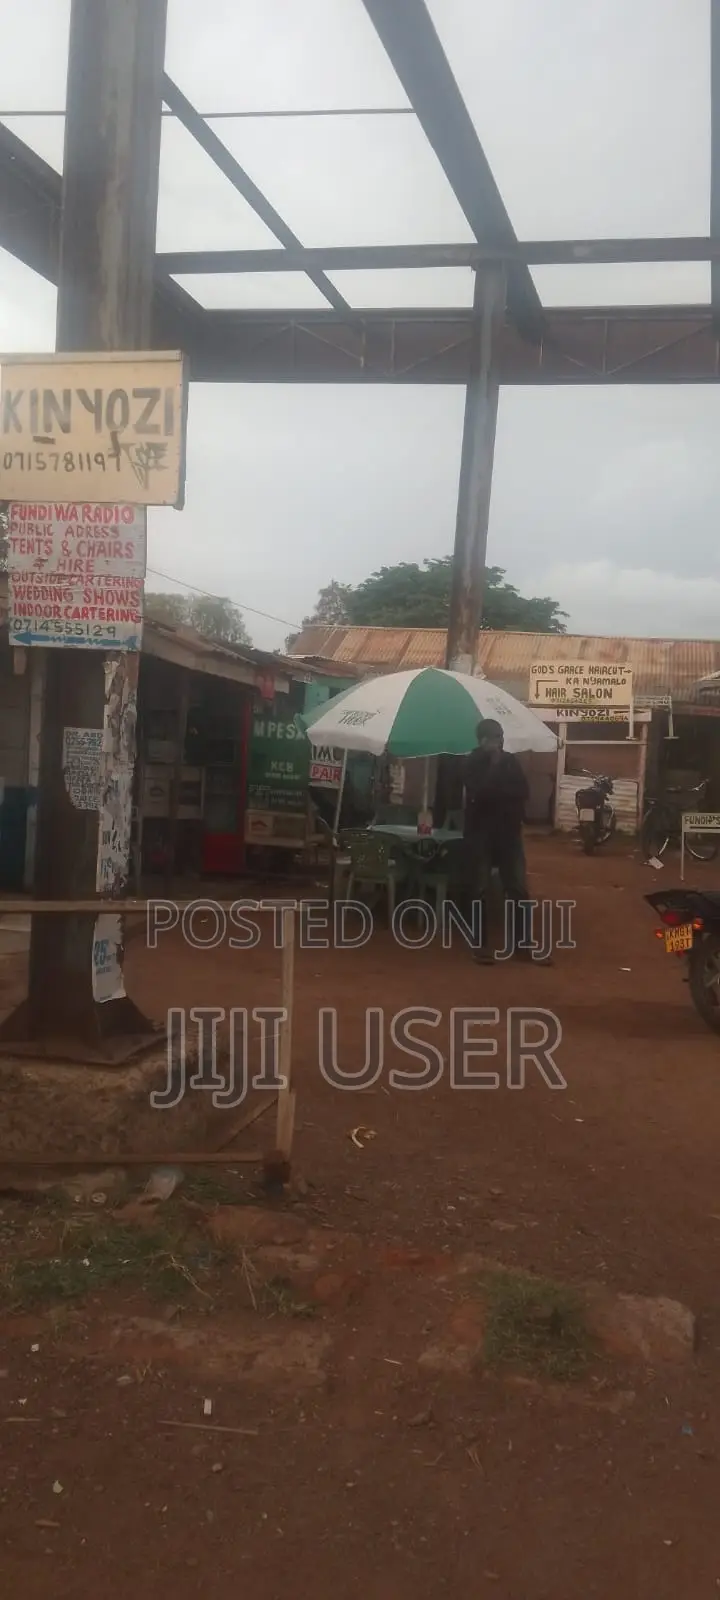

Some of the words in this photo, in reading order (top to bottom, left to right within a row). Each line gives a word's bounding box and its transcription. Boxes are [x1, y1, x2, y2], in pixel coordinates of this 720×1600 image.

[3, 387, 175, 436] KINYOZI
[11, 503, 52, 521] FUNDI
[54, 503, 79, 522] WA
[82, 503, 135, 524] RADIO
[10, 522, 54, 537] PUBLIC
[65, 525, 120, 539] ADRESS
[10, 538, 53, 555] TENTS
[61, 540, 72, 557] &
[76, 541, 135, 559] CHAIRS
[56, 558, 95, 573] HIRE
[12, 585, 74, 602] WEDDING
[83, 588, 139, 607] SHOWS
[13, 603, 61, 619] INDOOR
[64, 605, 141, 624] CARTERING
[13, 620, 116, 638] 0714555129
[531, 665, 555, 675] GOD'S
[545, 687, 567, 699] HAIR
[573, 687, 613, 699] SALON
[556, 709, 610, 717] KINYOZI
